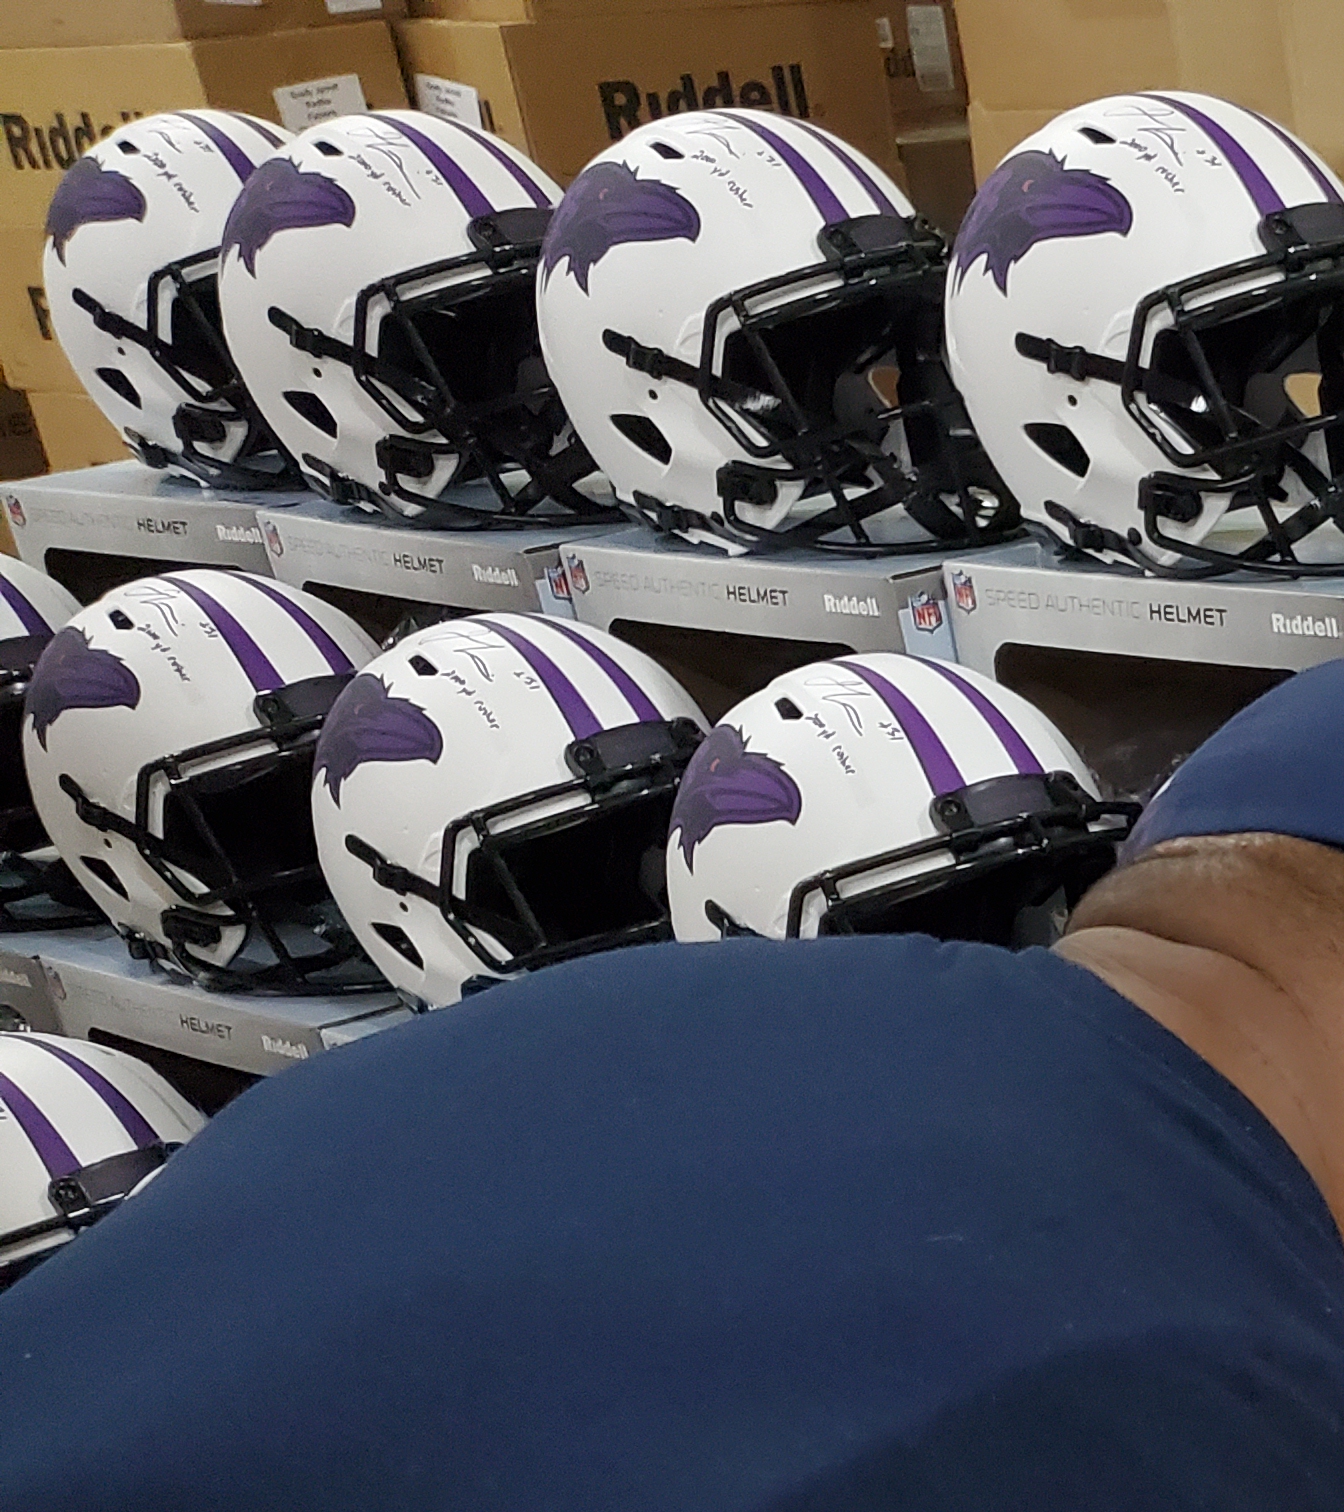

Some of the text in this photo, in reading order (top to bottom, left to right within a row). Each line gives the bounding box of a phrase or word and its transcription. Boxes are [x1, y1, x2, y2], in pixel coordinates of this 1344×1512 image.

[137, 519, 188, 535] HELMET
[393, 552, 444, 574] HELMET
[471, 563, 518, 587] Riddell
[726, 584, 789, 606] HELMET
[824, 594, 880, 617] Riddell
[985, 588, 1228, 628] SPEED AUTHENTIC HELMET
[1271, 612, 1339, 638] Riddell
[180, 1013, 233, 1040] HELMET
